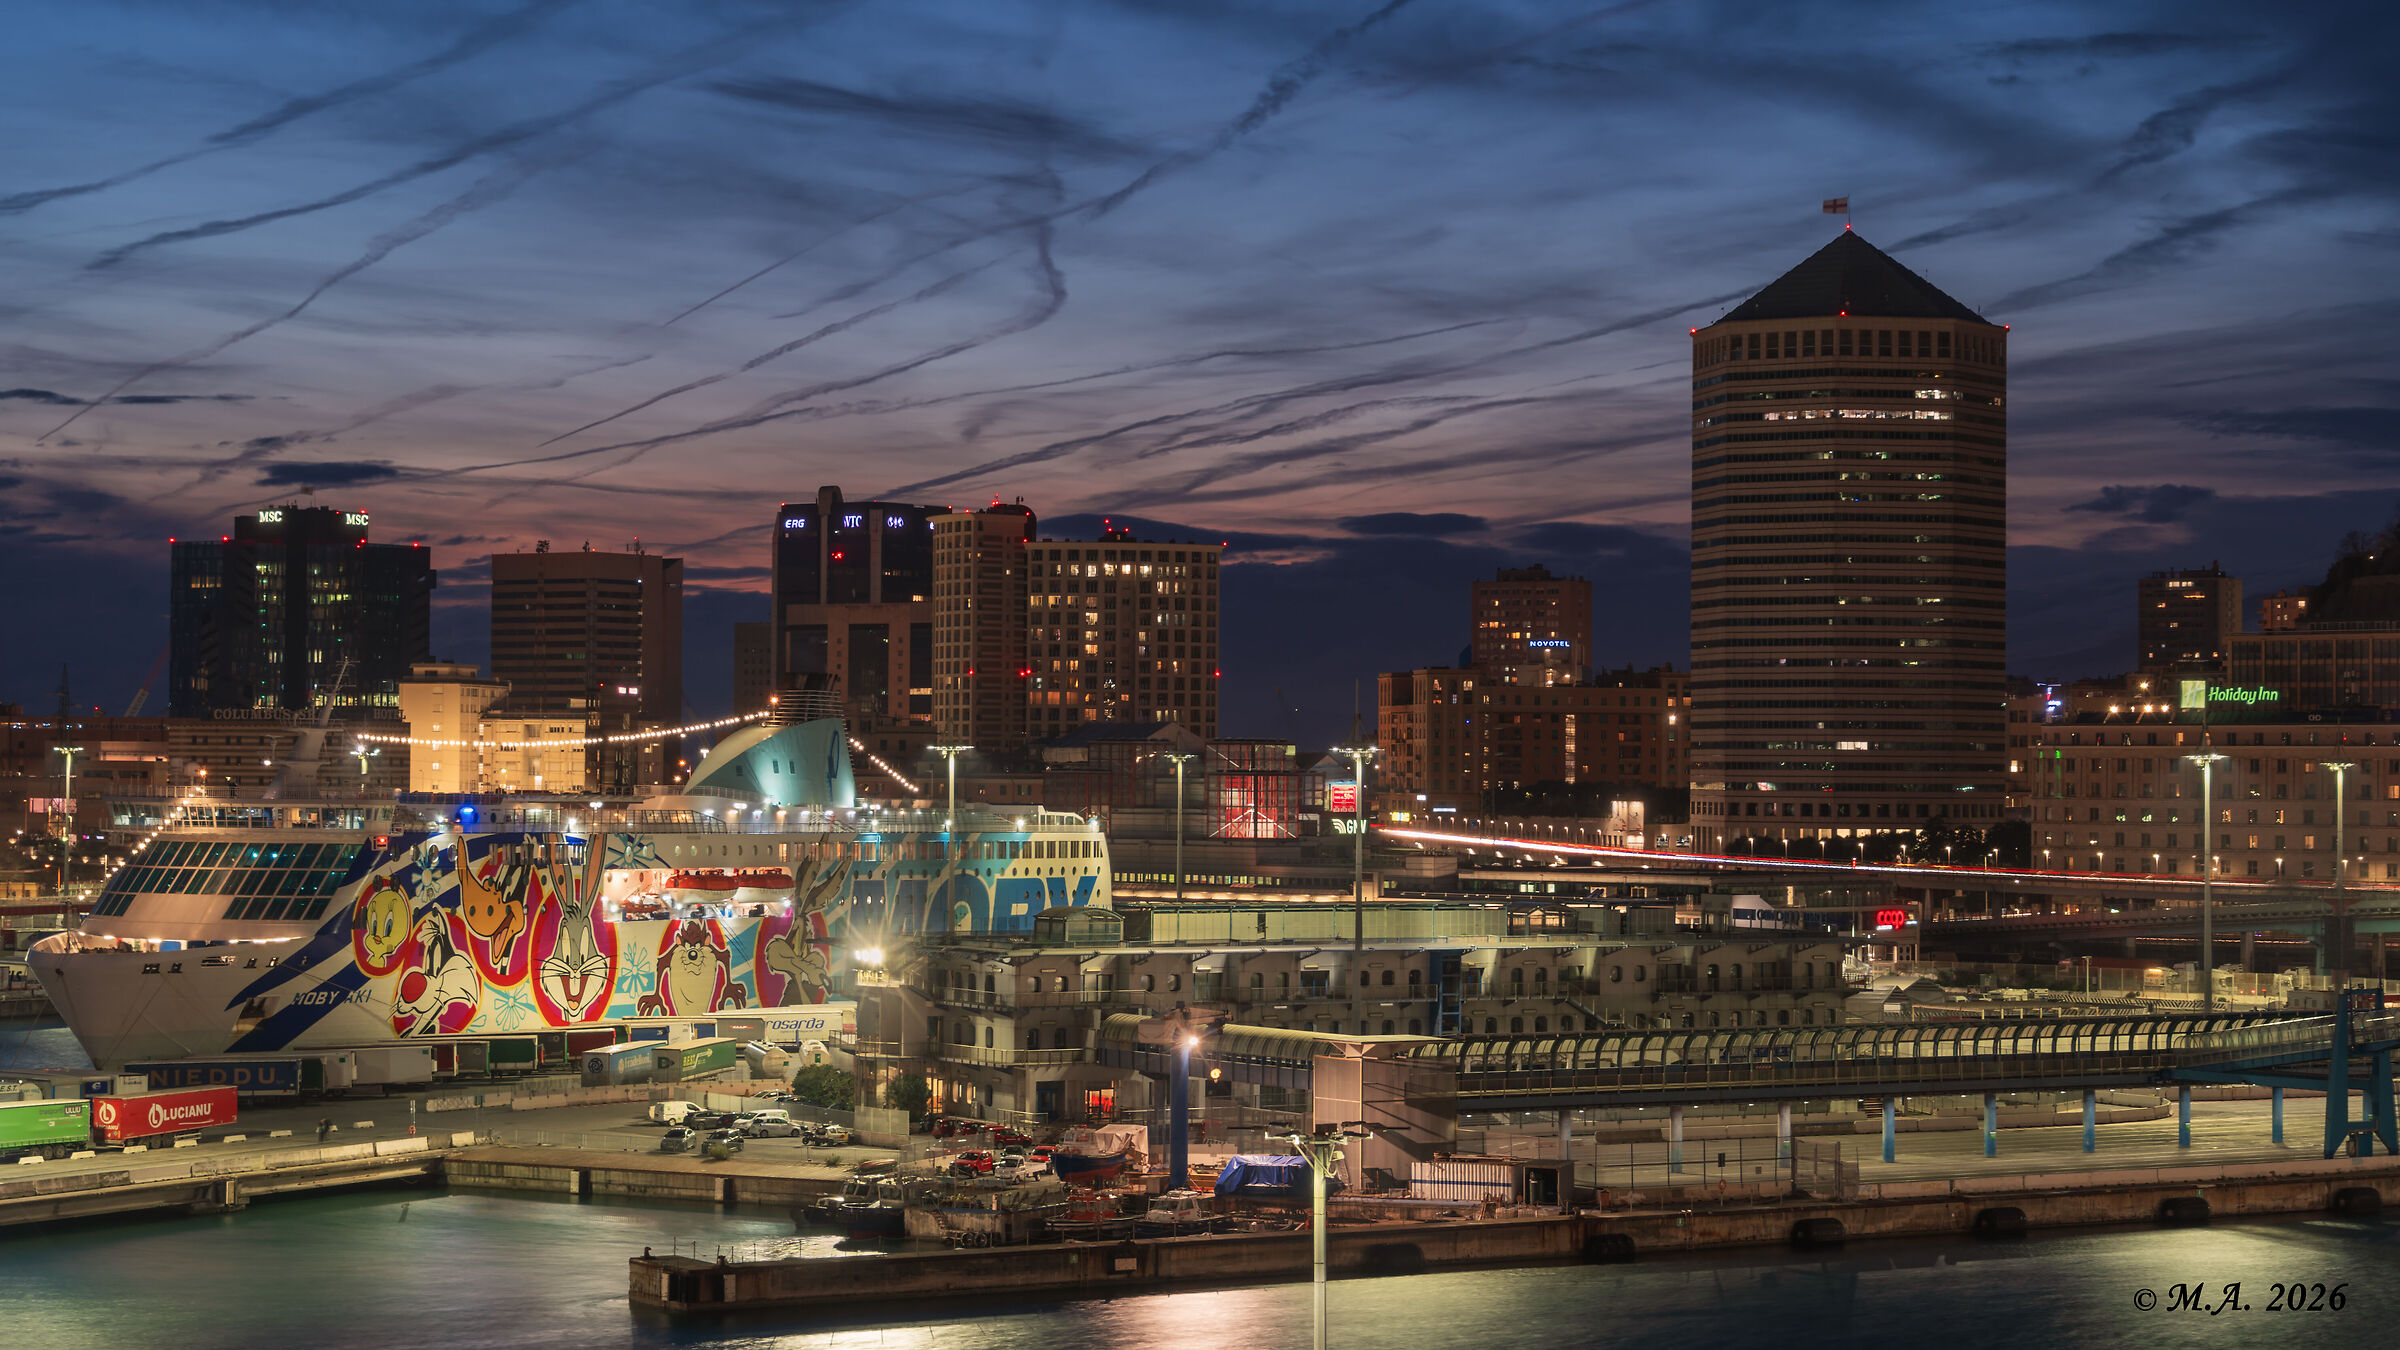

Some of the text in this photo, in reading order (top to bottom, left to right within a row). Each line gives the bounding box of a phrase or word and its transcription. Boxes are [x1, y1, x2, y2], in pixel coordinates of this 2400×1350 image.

[259, 511, 282, 523] MSC
[346, 513, 368, 526] MSC
[785, 519, 805, 528] ERG
[2208, 686, 2278, 705] Holiday Inn
[214, 708, 291, 720] COLUMBUS
[373, 708, 406, 720] HOTEL
[1877, 910, 1905, 930] coop
[292, 989, 372, 1005] MOBY AKI
[151, 1067, 275, 1087] NIEDDU
[163, 1103, 212, 1122] LUCIANU
